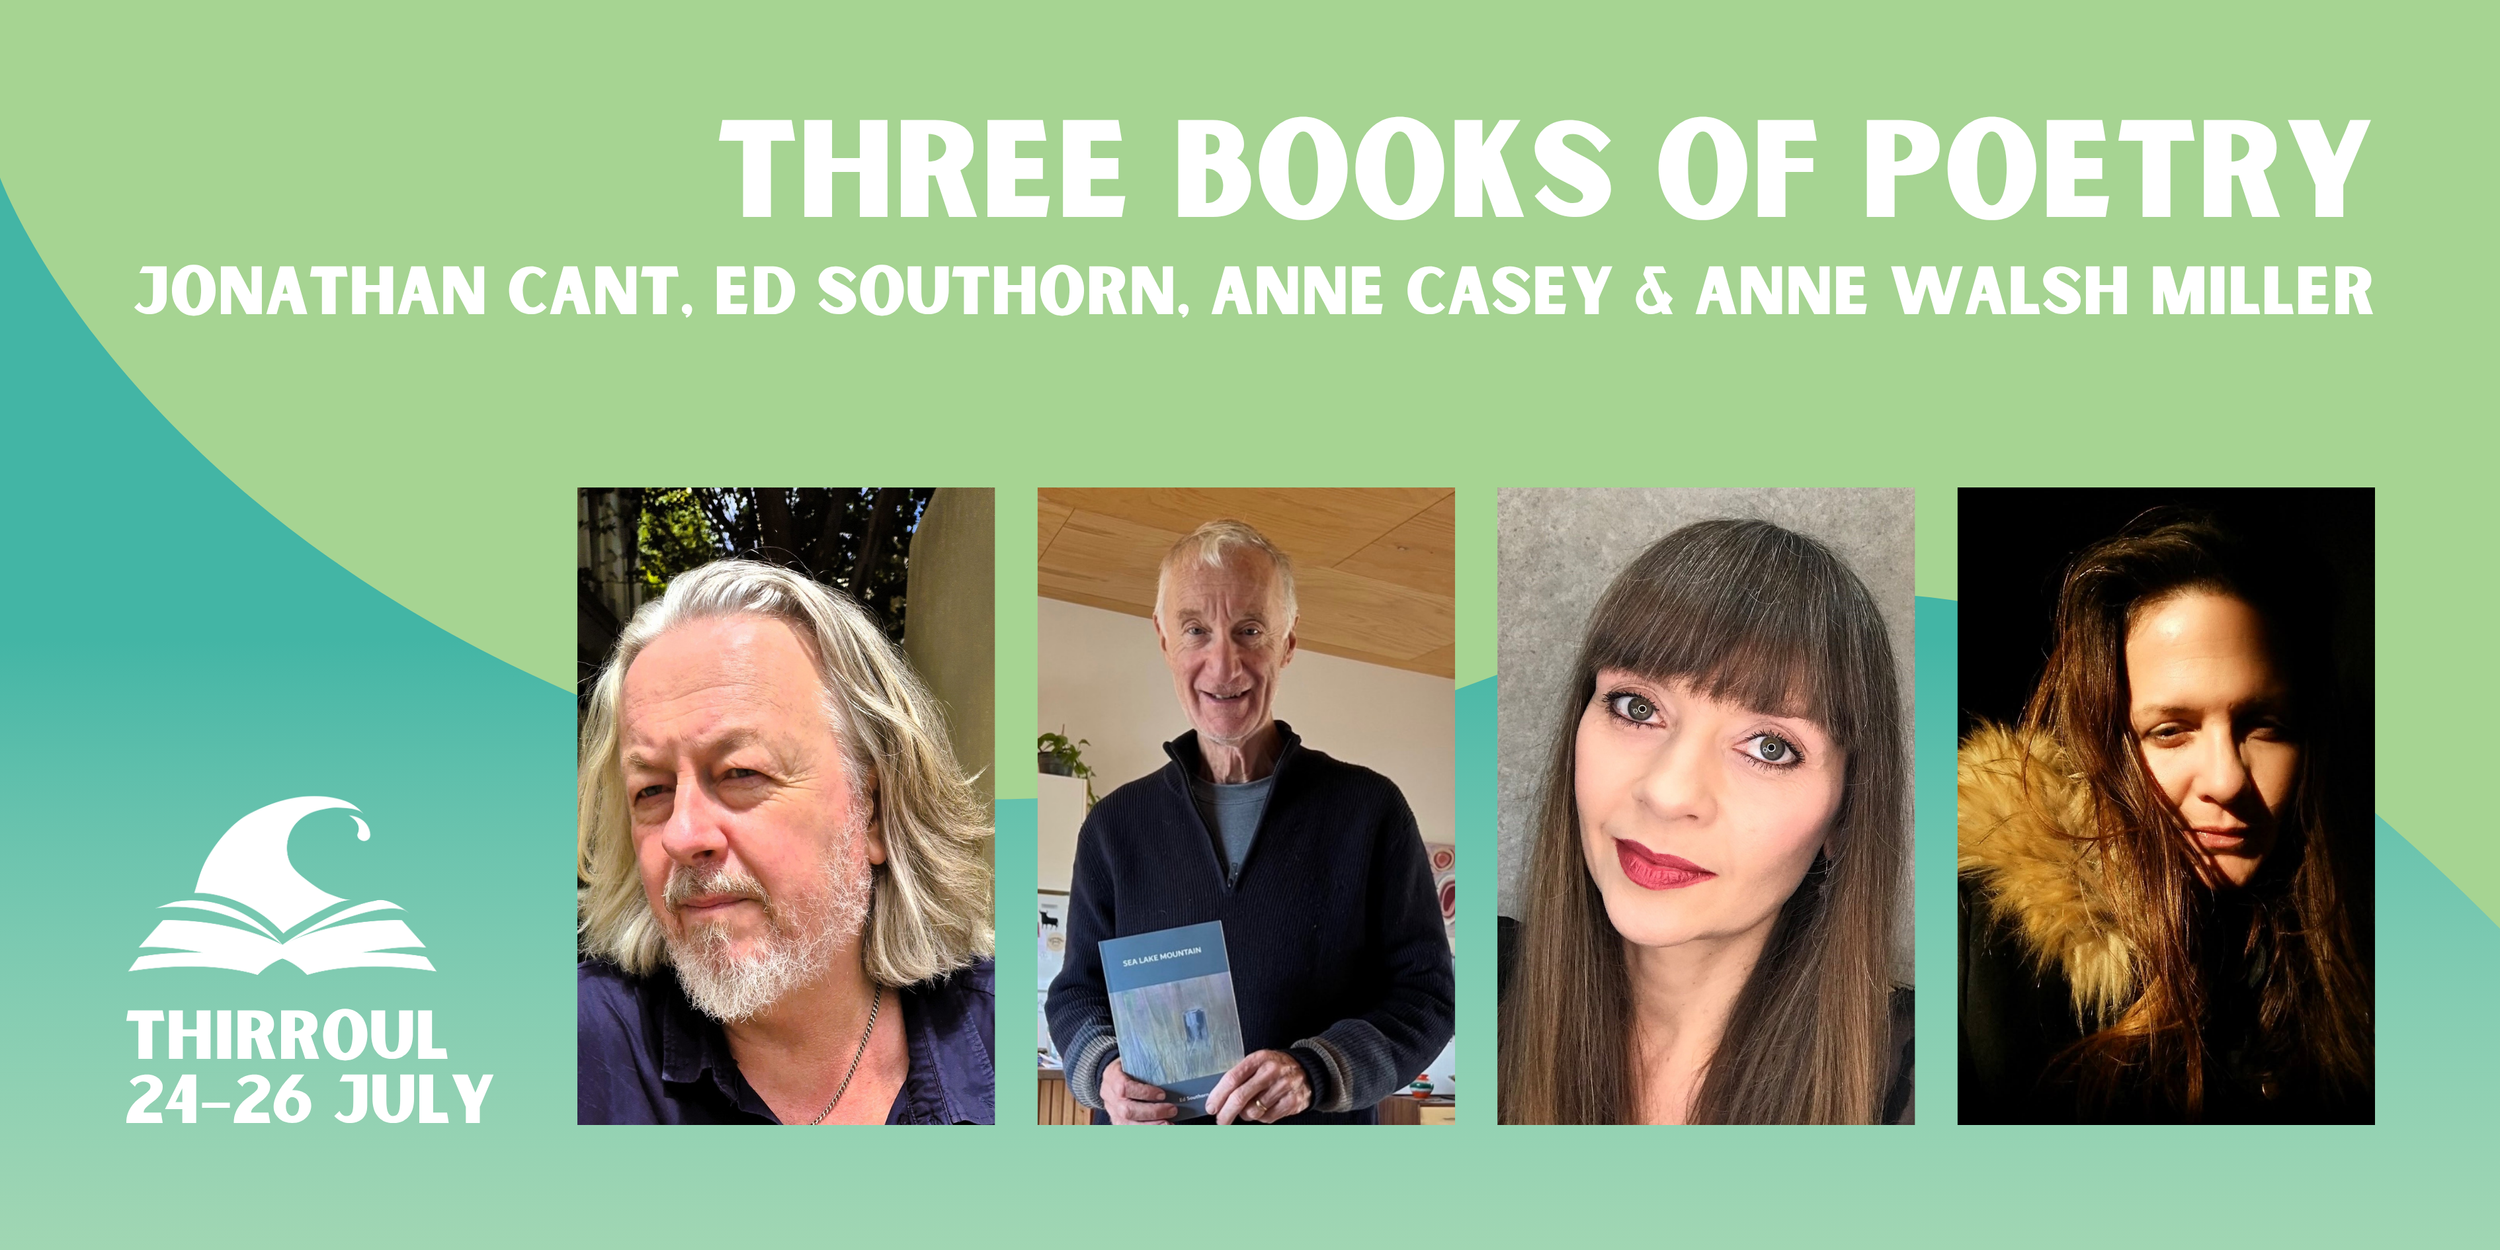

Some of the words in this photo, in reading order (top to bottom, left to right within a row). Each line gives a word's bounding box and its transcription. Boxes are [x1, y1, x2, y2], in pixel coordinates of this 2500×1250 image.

[719, 119, 1126, 218] THREE
[1177, 116, 1612, 221] BOOKS
[1658, 116, 1817, 221] OF
[1866, 116, 2371, 221] POETRY
[134, 265, 485, 317] JONATHAN
[508, 265, 693, 318] CANT,
[716, 266, 796, 315] ED
[818, 265, 1189, 318] SOUTHORN,
[1211, 266, 1383, 315] ANNE
[1407, 265, 1613, 316] CASEY
[1635, 265, 1673, 316] &
[1695, 266, 1867, 315] ANNE
[1891, 265, 2128, 316] WALSH
[2152, 266, 2374, 315] MILLER
[1122, 958, 1138, 967] SEA
[1138, 953, 1159, 964] LAKE
[1159, 946, 1202, 960] MOUNTAIN
[126, 1008, 448, 1061] THIRROUL
[334, 1074, 494, 1124] JULY
